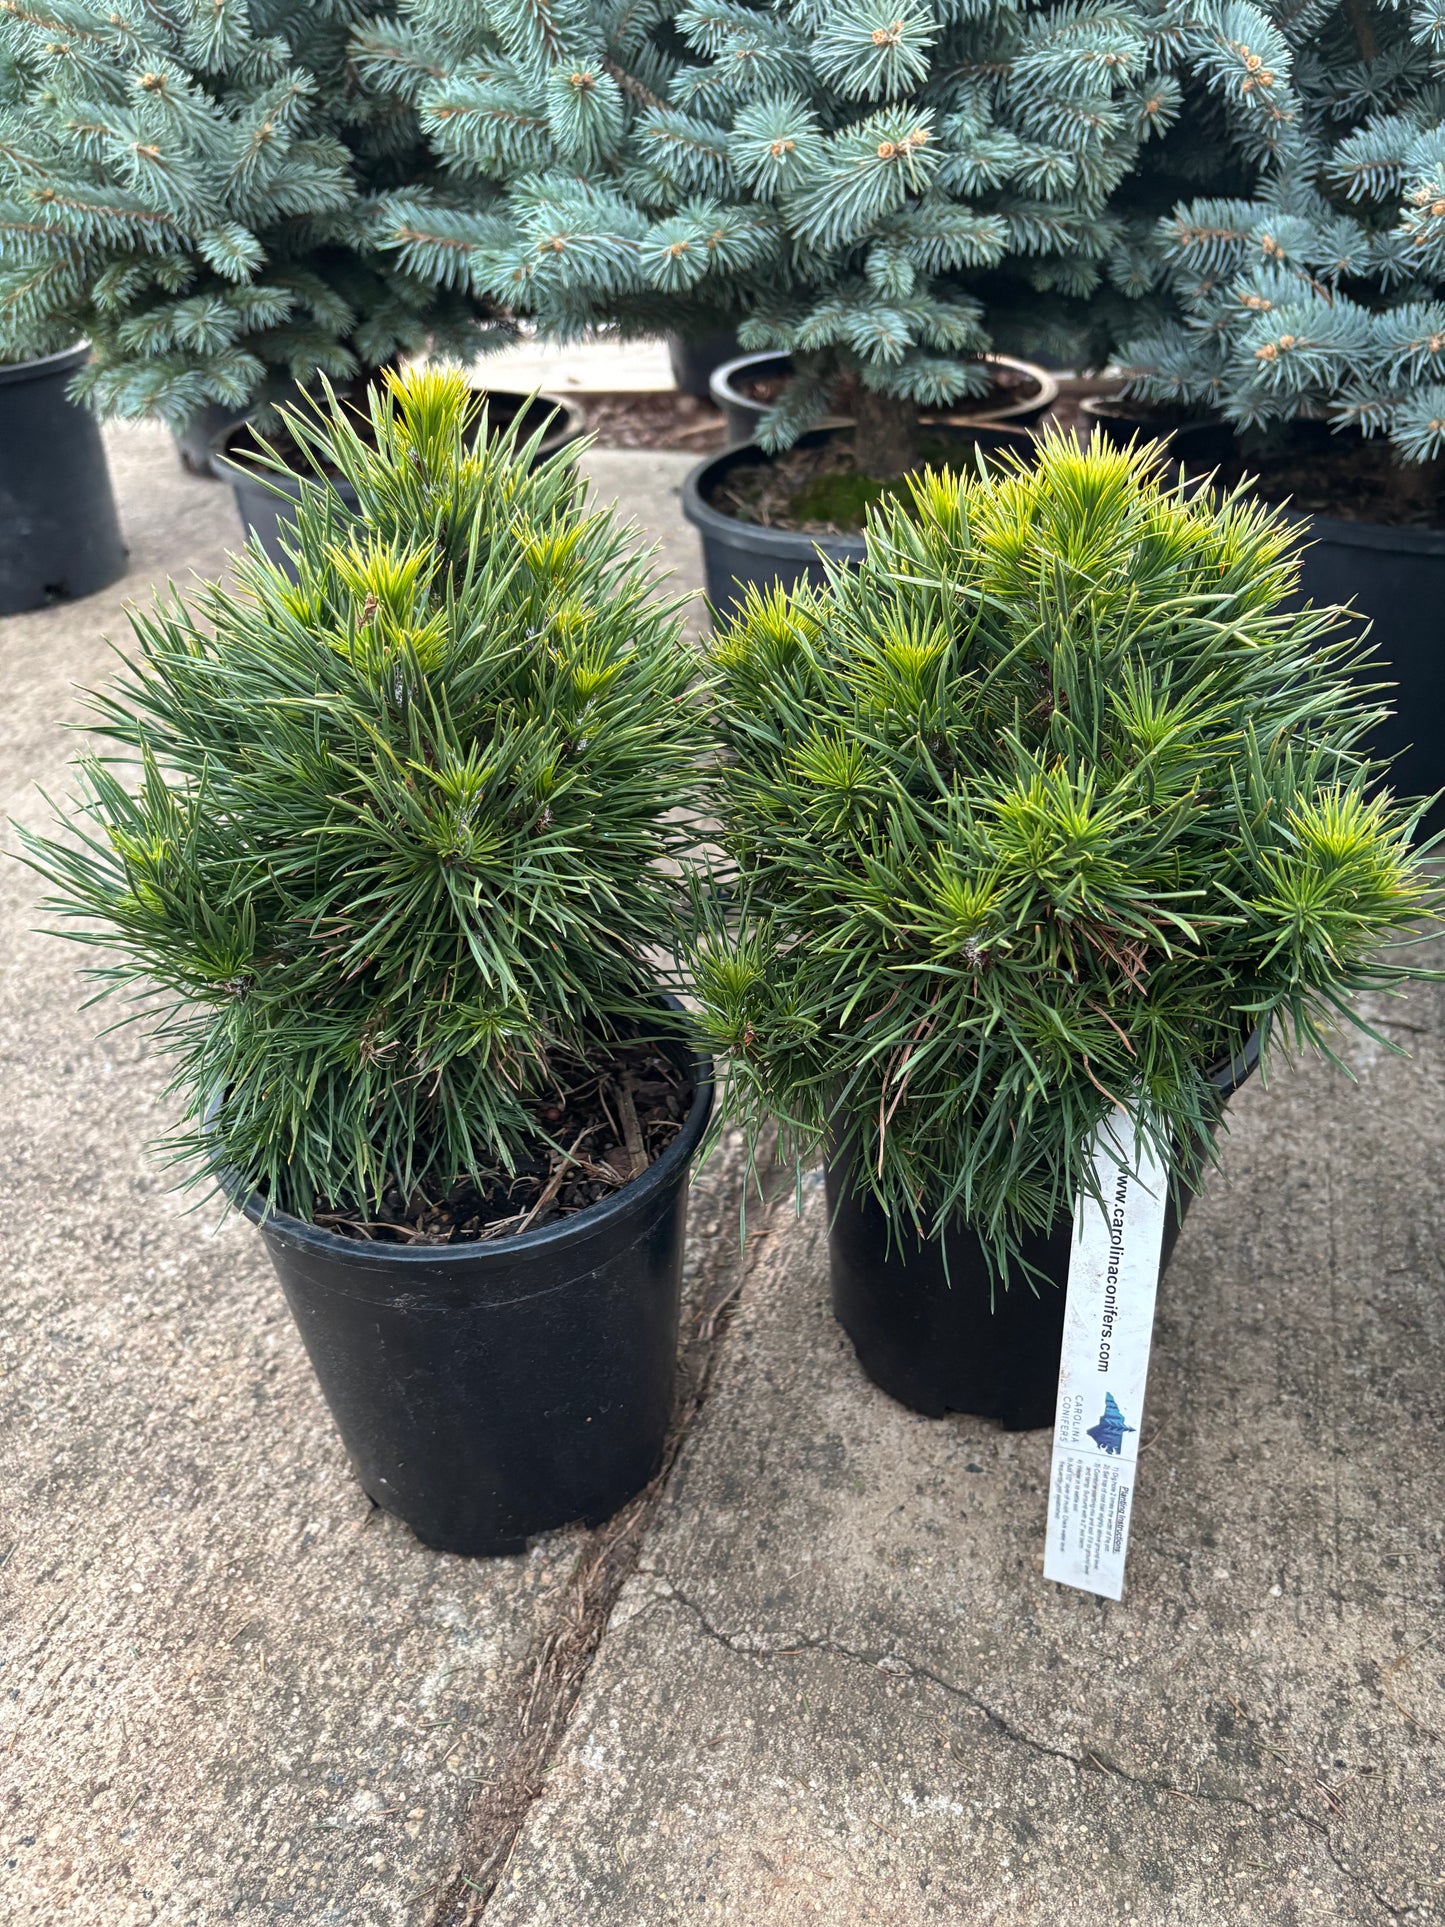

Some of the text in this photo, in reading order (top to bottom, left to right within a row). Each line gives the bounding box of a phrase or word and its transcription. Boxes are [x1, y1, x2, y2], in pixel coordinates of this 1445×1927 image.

[1059, 1396, 1072, 1442] CONIFERS
[1071, 1395, 1084, 1443] CAROLINA
[1116, 1486, 1128, 1513] Planting
